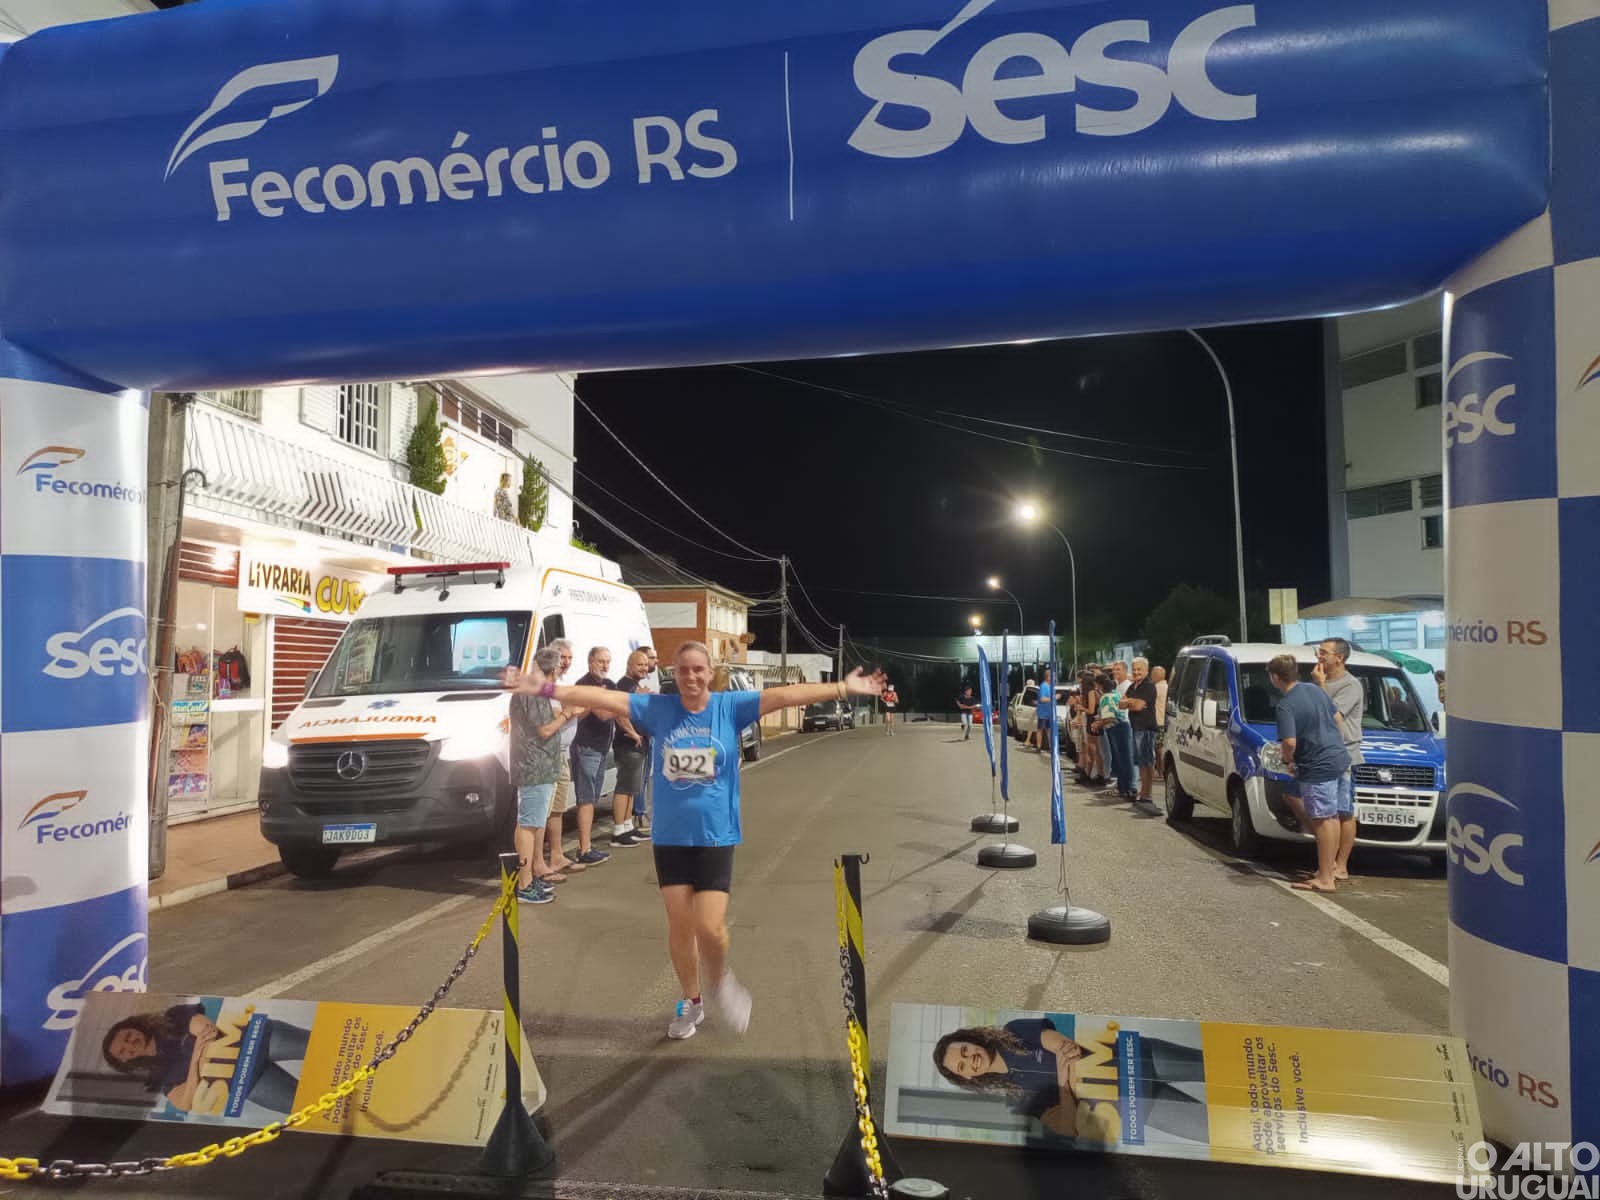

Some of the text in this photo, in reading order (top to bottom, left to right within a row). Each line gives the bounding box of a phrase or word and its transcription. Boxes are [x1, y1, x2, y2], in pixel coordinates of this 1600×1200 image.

[209, 109, 738, 222] Fecomércio RS
[1507, 620, 1548, 646] RS
[670, 755, 706, 774] 922
[339, 1019, 353, 1056] mundo
[353, 1055, 361, 1069] do
[1127, 1059, 1135, 1075] SER
[1243, 1037, 1256, 1079] mundo
[1128, 1077, 1137, 1108] PODEM
[1248, 1083, 1259, 1113] todo
[1255, 1036, 1275, 1155] pode aproveitar os
[1268, 1042, 1286, 1151] serviços do Sesc.
[1289, 1052, 1309, 1144] Inclusive você.
[1518, 1071, 1559, 1109] RS
[1129, 1108, 1137, 1140] TODOS
